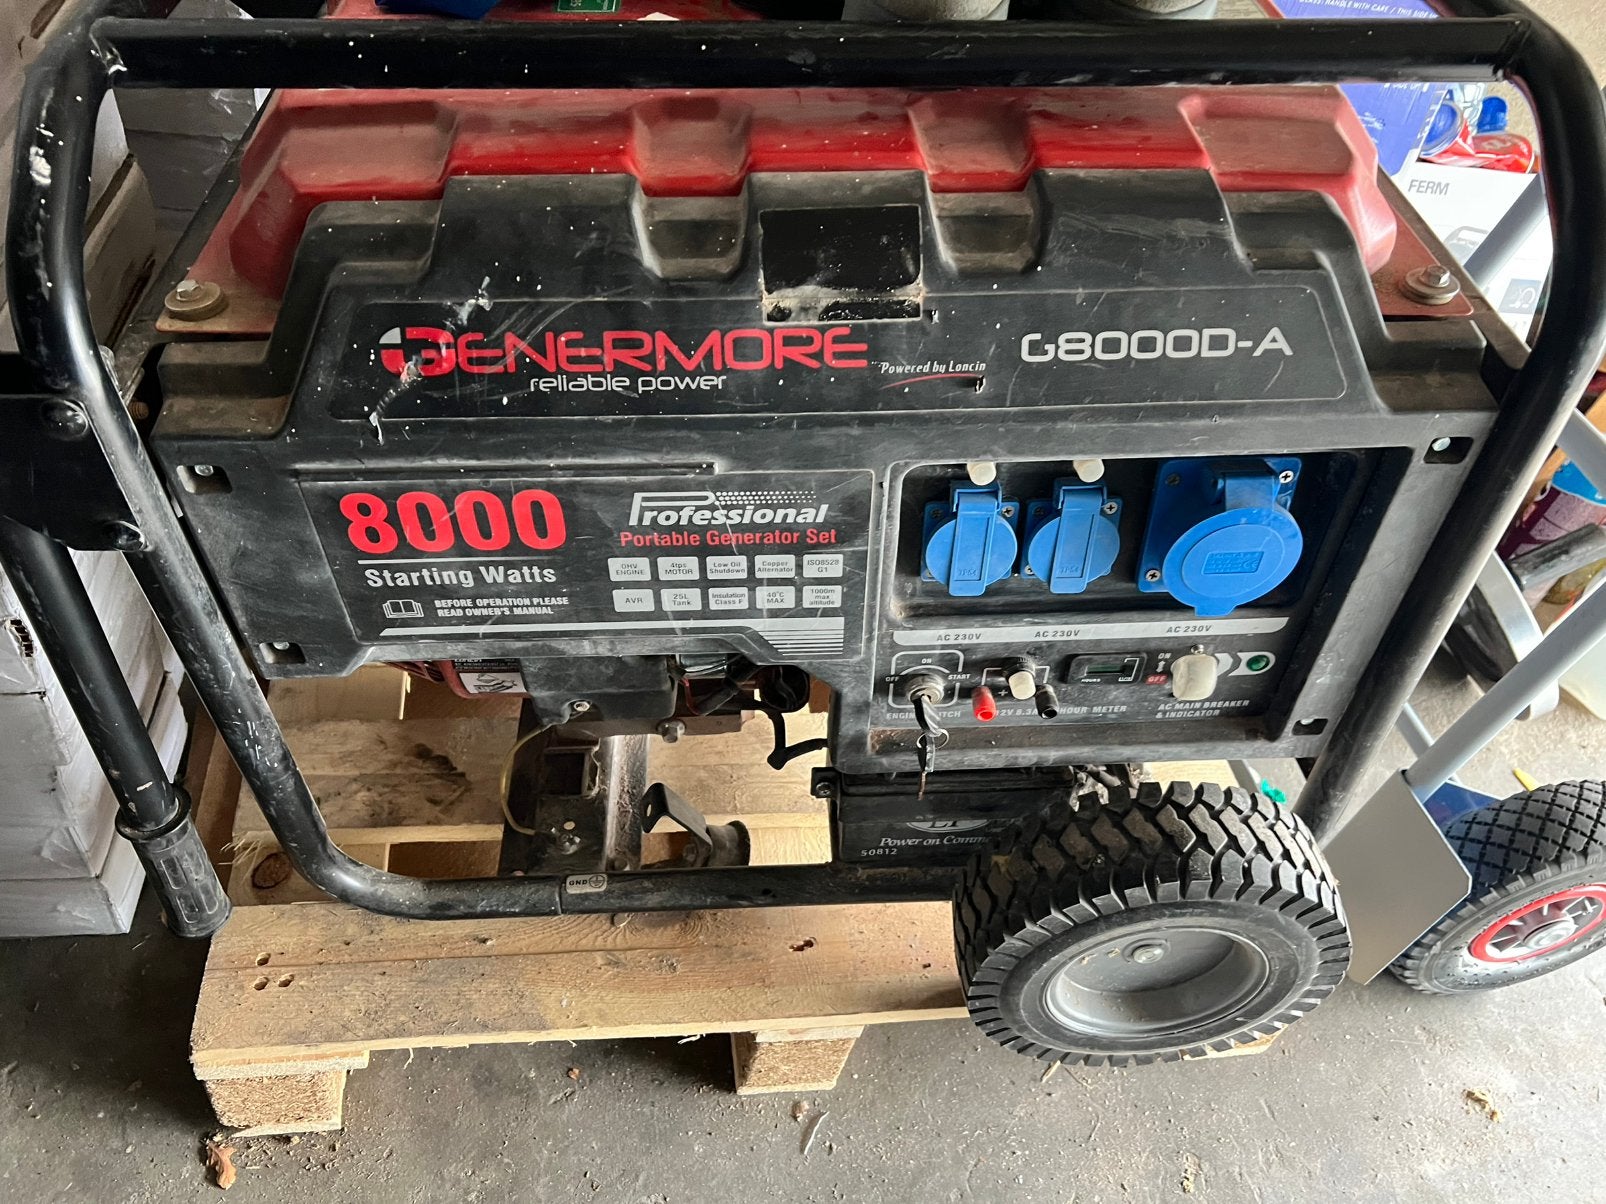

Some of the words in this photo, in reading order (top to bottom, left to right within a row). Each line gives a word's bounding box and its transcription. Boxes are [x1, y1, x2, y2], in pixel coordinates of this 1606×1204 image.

[1407, 179, 1450, 196] FERM
[1020, 326, 1294, 363] G8000D-A
[378, 326, 868, 377] GENERMORE
[880, 361, 931, 374] Powered
[932, 360, 946, 374] by
[948, 360, 987, 372] Loncin
[530, 373, 630, 392] reliable
[637, 375, 727, 394] power
[628, 491, 830, 526] Professional
[339, 489, 567, 555] 8000
[619, 531, 701, 547] Portable
[706, 530, 800, 546] Generator
[806, 528, 837, 544] Set
[762, 560, 788, 568] Copper
[364, 567, 475, 588] Starting
[479, 565, 557, 584] Watts
[434, 599, 473, 608] BEFORE
[475, 597, 531, 607] OPERATION
[532, 596, 570, 606] PLEASE
[437, 608, 464, 617] READ
[465, 607, 510, 616] OWNER'S
[513, 606, 555, 615] MANUAL
[1034, 630, 1049, 638] AC
[1051, 629, 1081, 638] 230V
[1166, 626, 1181, 634] AC
[1183, 625, 1212, 633] 230V
[936, 633, 951, 642] AC
[953, 633, 982, 641] 230V
[1147, 674, 1168, 683] OFF
[1059, 706, 1088, 714] HOUR
[1092, 705, 1128, 713] METER
[1157, 703, 1172, 711] AC
[1173, 701, 1201, 710] MAIN
[1202, 699, 1250, 709] BREAKER
[886, 712, 916, 720] ENGIN
[1155, 711, 1163, 719] &
[1165, 709, 1220, 718] INDICATOR
[879, 836, 923, 847] Power
[923, 838, 940, 846] on
